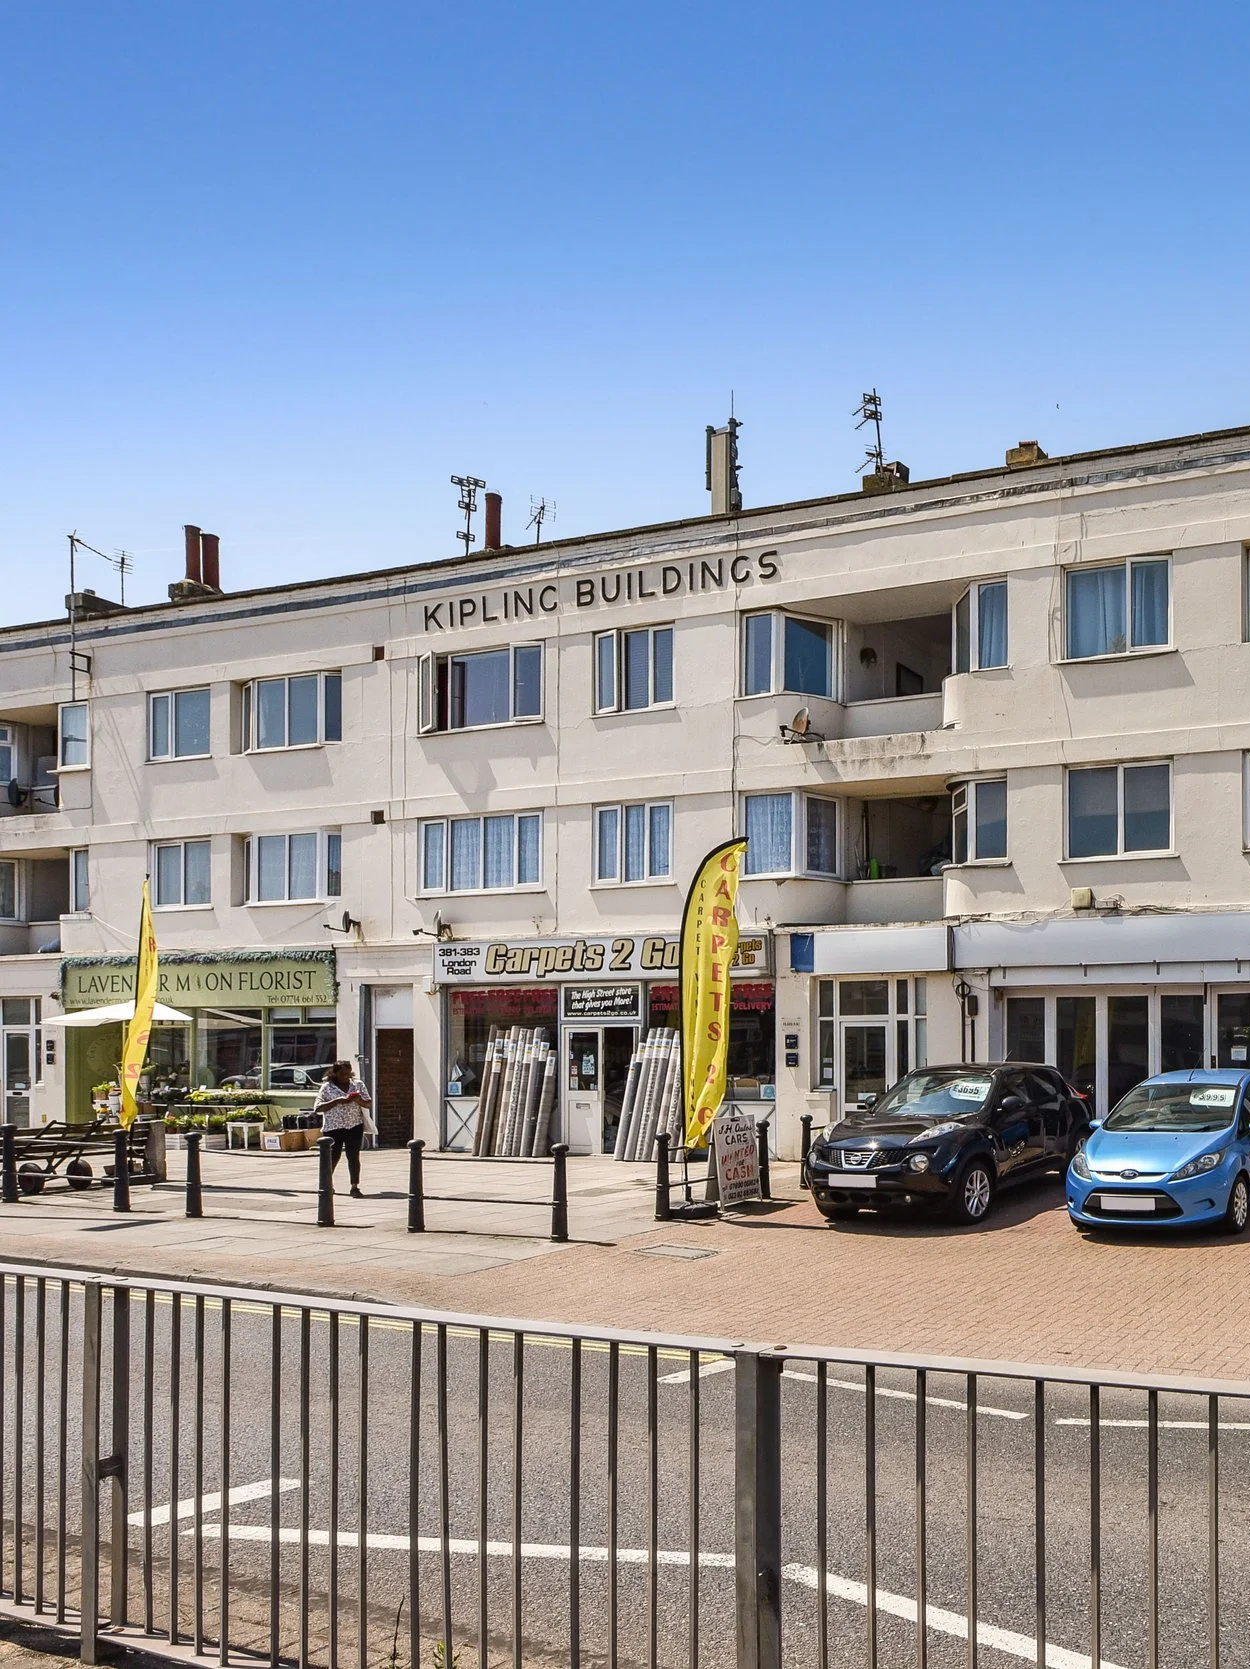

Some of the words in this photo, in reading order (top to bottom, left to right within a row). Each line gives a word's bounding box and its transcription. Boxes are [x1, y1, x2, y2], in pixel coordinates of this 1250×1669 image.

[424, 585, 557, 631] KIPLING
[576, 550, 779, 607] BUILDINGS
[696, 879, 707, 955] CARPET
[439, 947, 480, 957] 381-383
[707, 853, 737, 1042] CARPETS
[735, 938, 763, 954] rpets
[442, 958, 477, 967] London
[485, 940, 604, 978] Carpets
[609, 938, 634, 971] 2
[742, 952, 756, 965] Go
[446, 967, 472, 975] Road
[78, 974, 170, 993] LAVENR
[176, 971, 233, 991] MON
[239, 970, 317, 990] FLORIST
[571, 991, 582, 1000] The
[582, 989, 596, 1001] High
[596, 988, 615, 998] Street
[615, 987, 632, 996] store
[571, 1001, 585, 1010] that
[585, 1000, 600, 1011] gives
[600, 1000, 613, 1010] you
[613, 995, 634, 1006] More!
[651, 1003, 679, 1011] ESTIMAT
[725, 1133, 748, 1145] CARS
[725, 1165, 754, 1181] CASH
